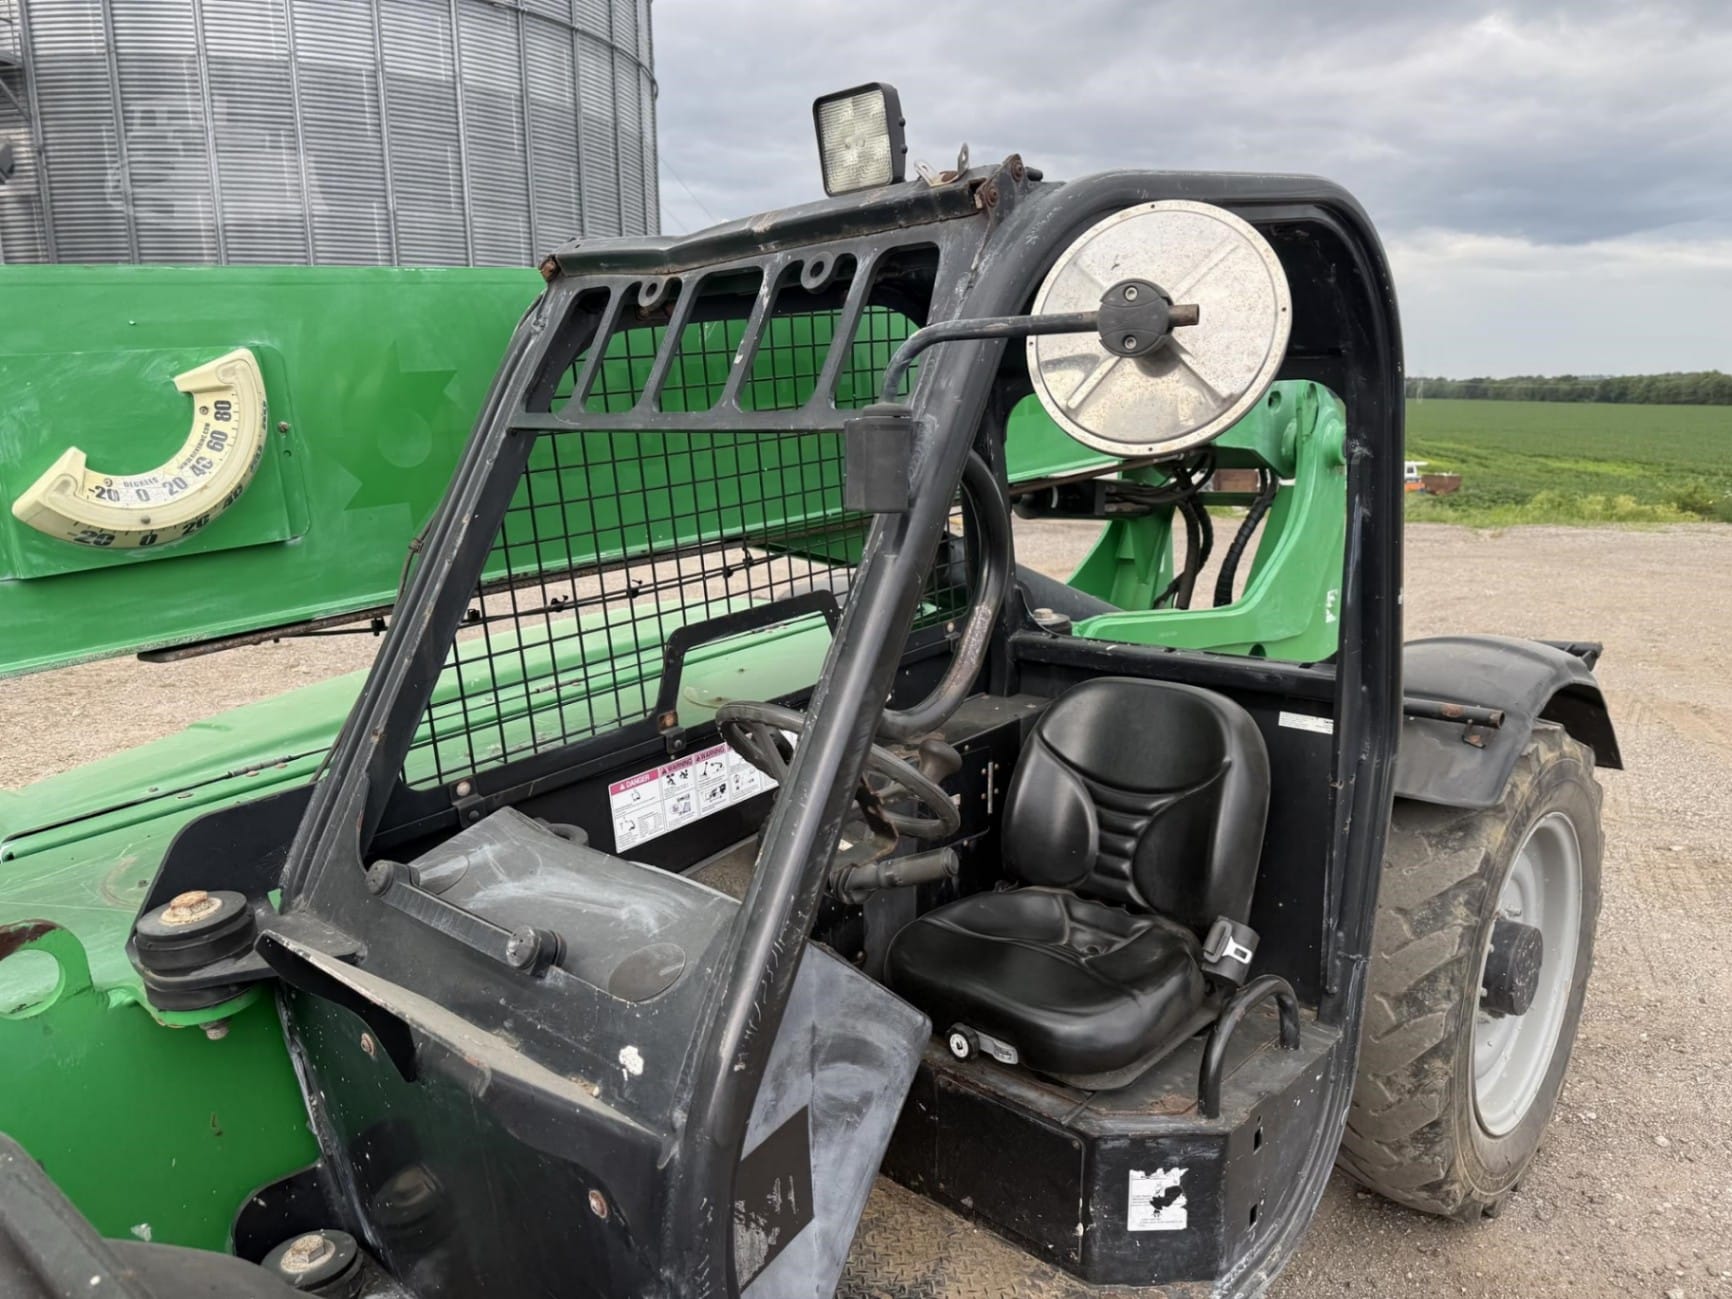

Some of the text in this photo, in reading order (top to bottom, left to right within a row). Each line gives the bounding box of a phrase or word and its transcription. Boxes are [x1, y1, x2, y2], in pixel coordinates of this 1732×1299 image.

[214, 400, 232, 422] 80
[207, 430, 228, 452] 60
[163, 477, 187, 496] 20
[136, 488, 150, 502] 0
[700, 745, 725, 759] WARNING
[626, 774, 650, 787] DANGER
